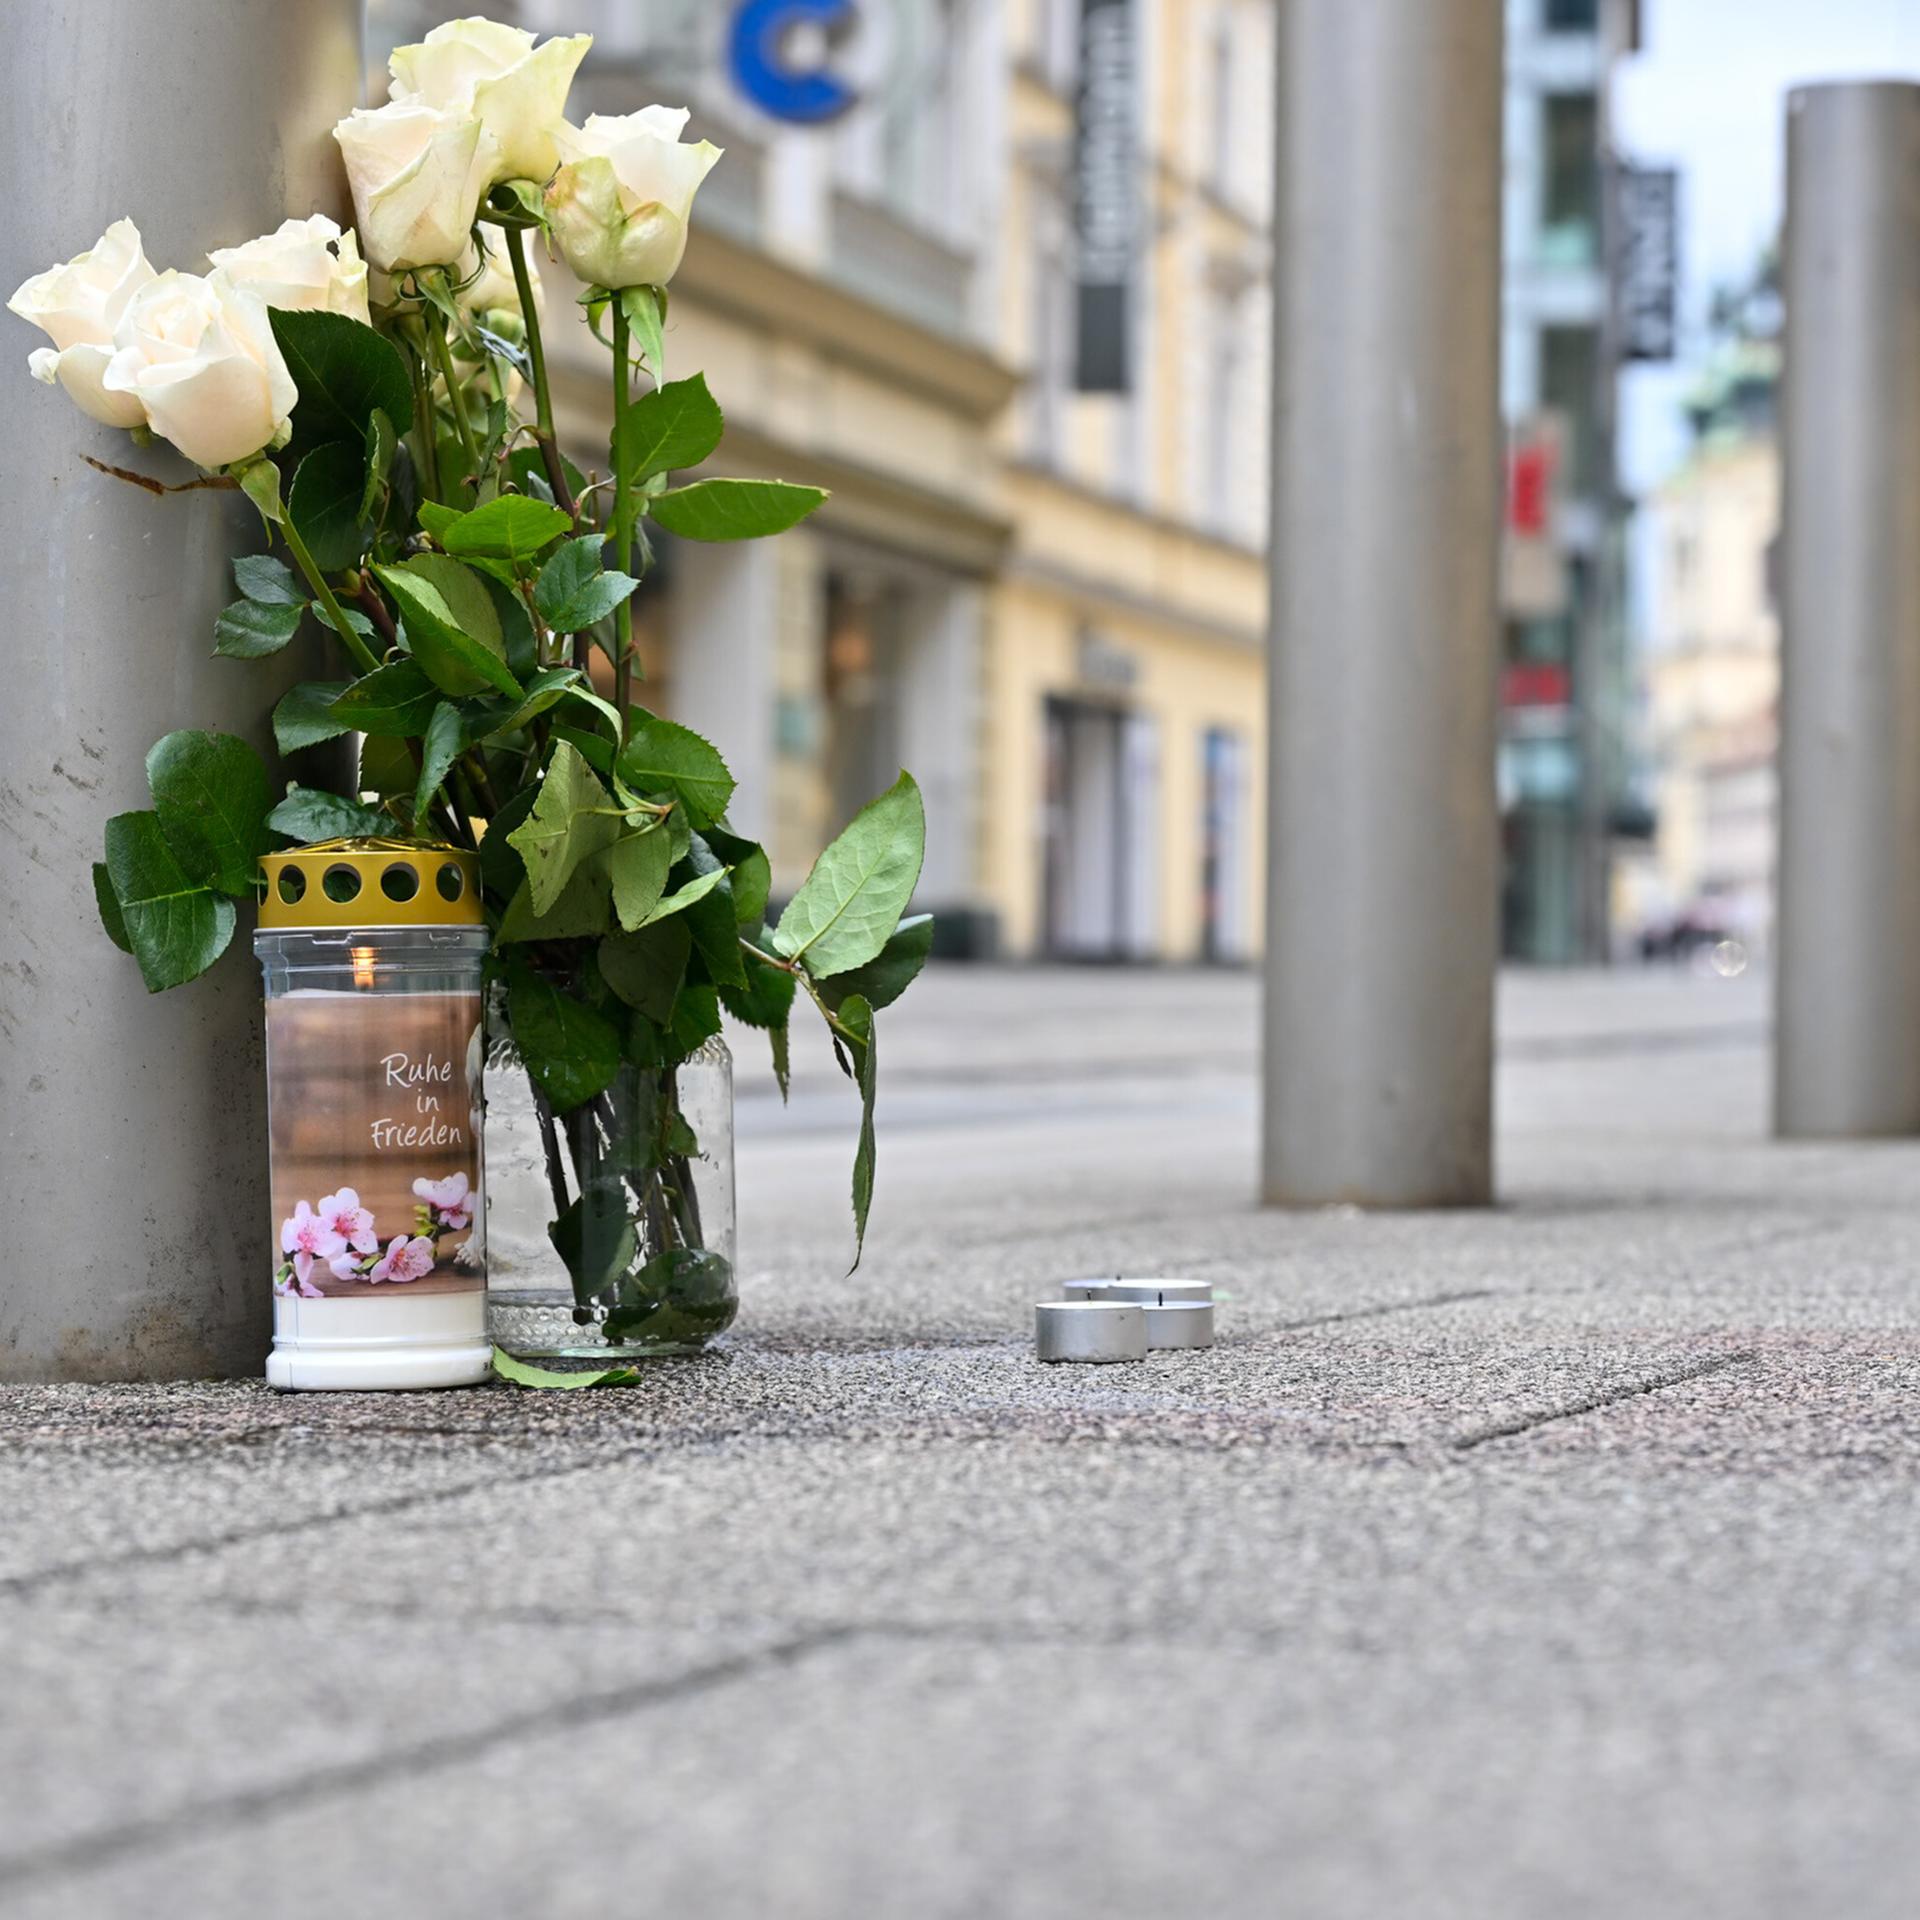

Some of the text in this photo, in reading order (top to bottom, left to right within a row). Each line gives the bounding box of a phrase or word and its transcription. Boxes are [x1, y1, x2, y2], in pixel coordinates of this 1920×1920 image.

[380, 1053, 452, 1088] Ruhe
[416, 1088, 440, 1113] in
[370, 1116, 462, 1150] Frieden
